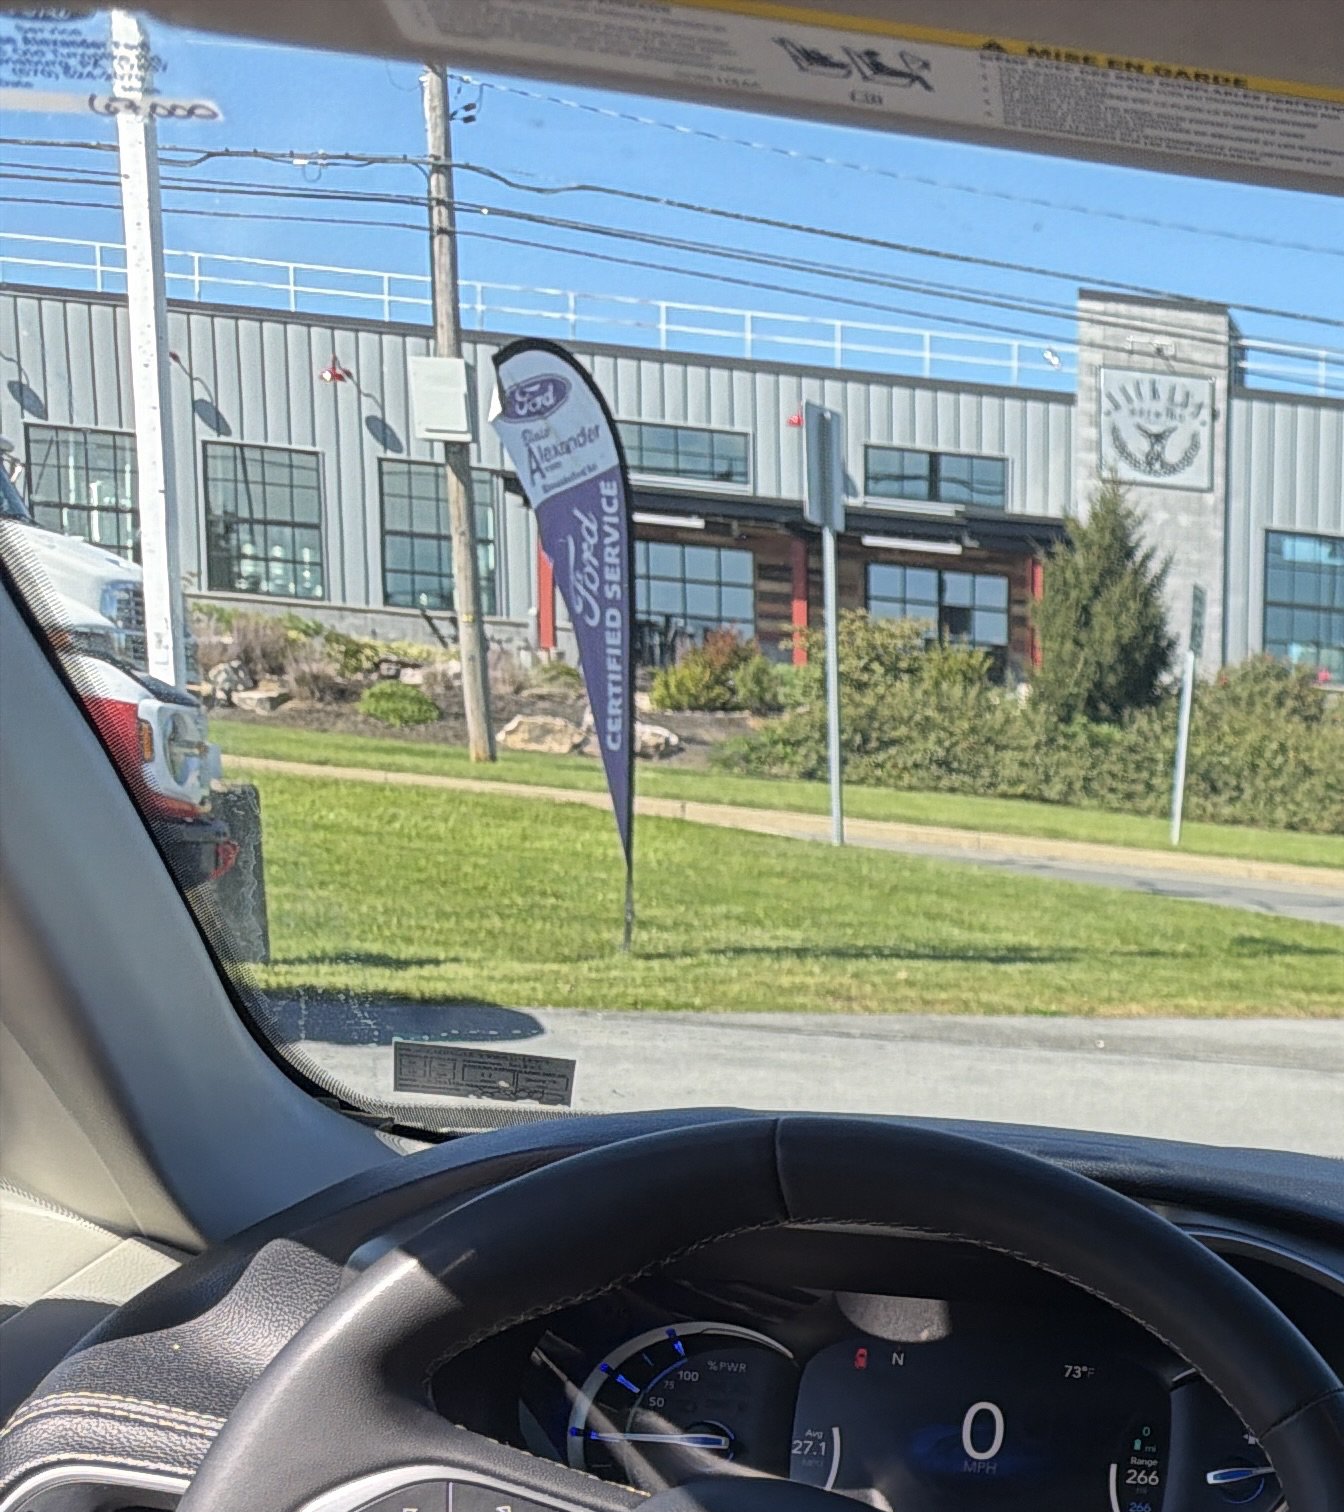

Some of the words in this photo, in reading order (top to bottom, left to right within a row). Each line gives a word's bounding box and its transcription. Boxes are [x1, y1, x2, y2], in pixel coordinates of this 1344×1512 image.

[1027, 46, 1097, 68] MISE
[1107, 57, 1145, 73] EN
[1152, 64, 1249, 89] GARDE
[526, 425, 600, 486] Alexander
[600, 480, 621, 600] SERVICE
[561, 508, 600, 626] Ford
[604, 608, 622, 751] CERTIFIED
[892, 1353, 905, 1366] N
[678, 1370, 699, 1382] 100
[649, 1396, 665, 1408] 50
[804, 1429, 824, 1441] Avg
[962, 1401, 1005, 1460] 0
[1142, 1426, 1151, 1437] 0
[791, 1440, 826, 1457] 27.1
[964, 1460, 998, 1475] MPH
[1130, 1456, 1159, 1468] Range
[1125, 1469, 1160, 1486] 266
